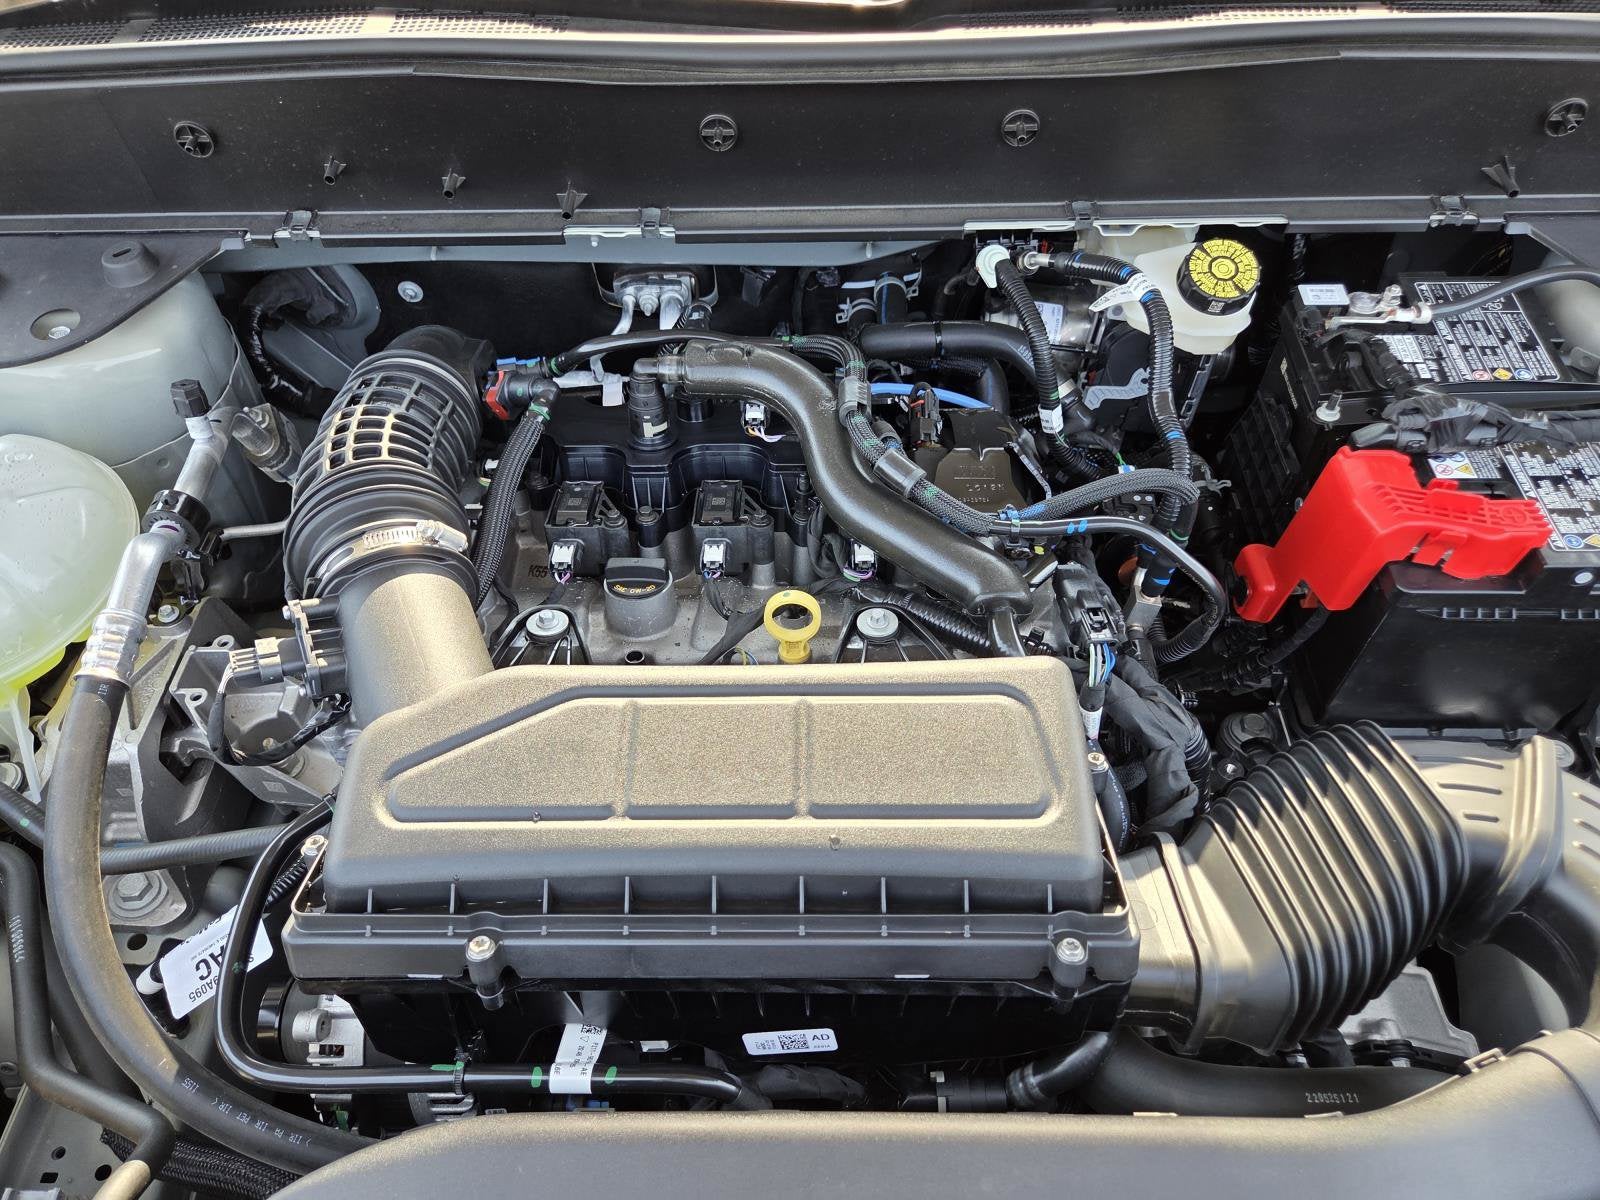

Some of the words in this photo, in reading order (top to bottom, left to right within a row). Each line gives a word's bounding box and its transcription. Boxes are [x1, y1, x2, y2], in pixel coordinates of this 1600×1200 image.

[614, 584, 627, 592] SAE
[195, 945, 226, 980] AC
[812, 1033, 830, 1041] AD
